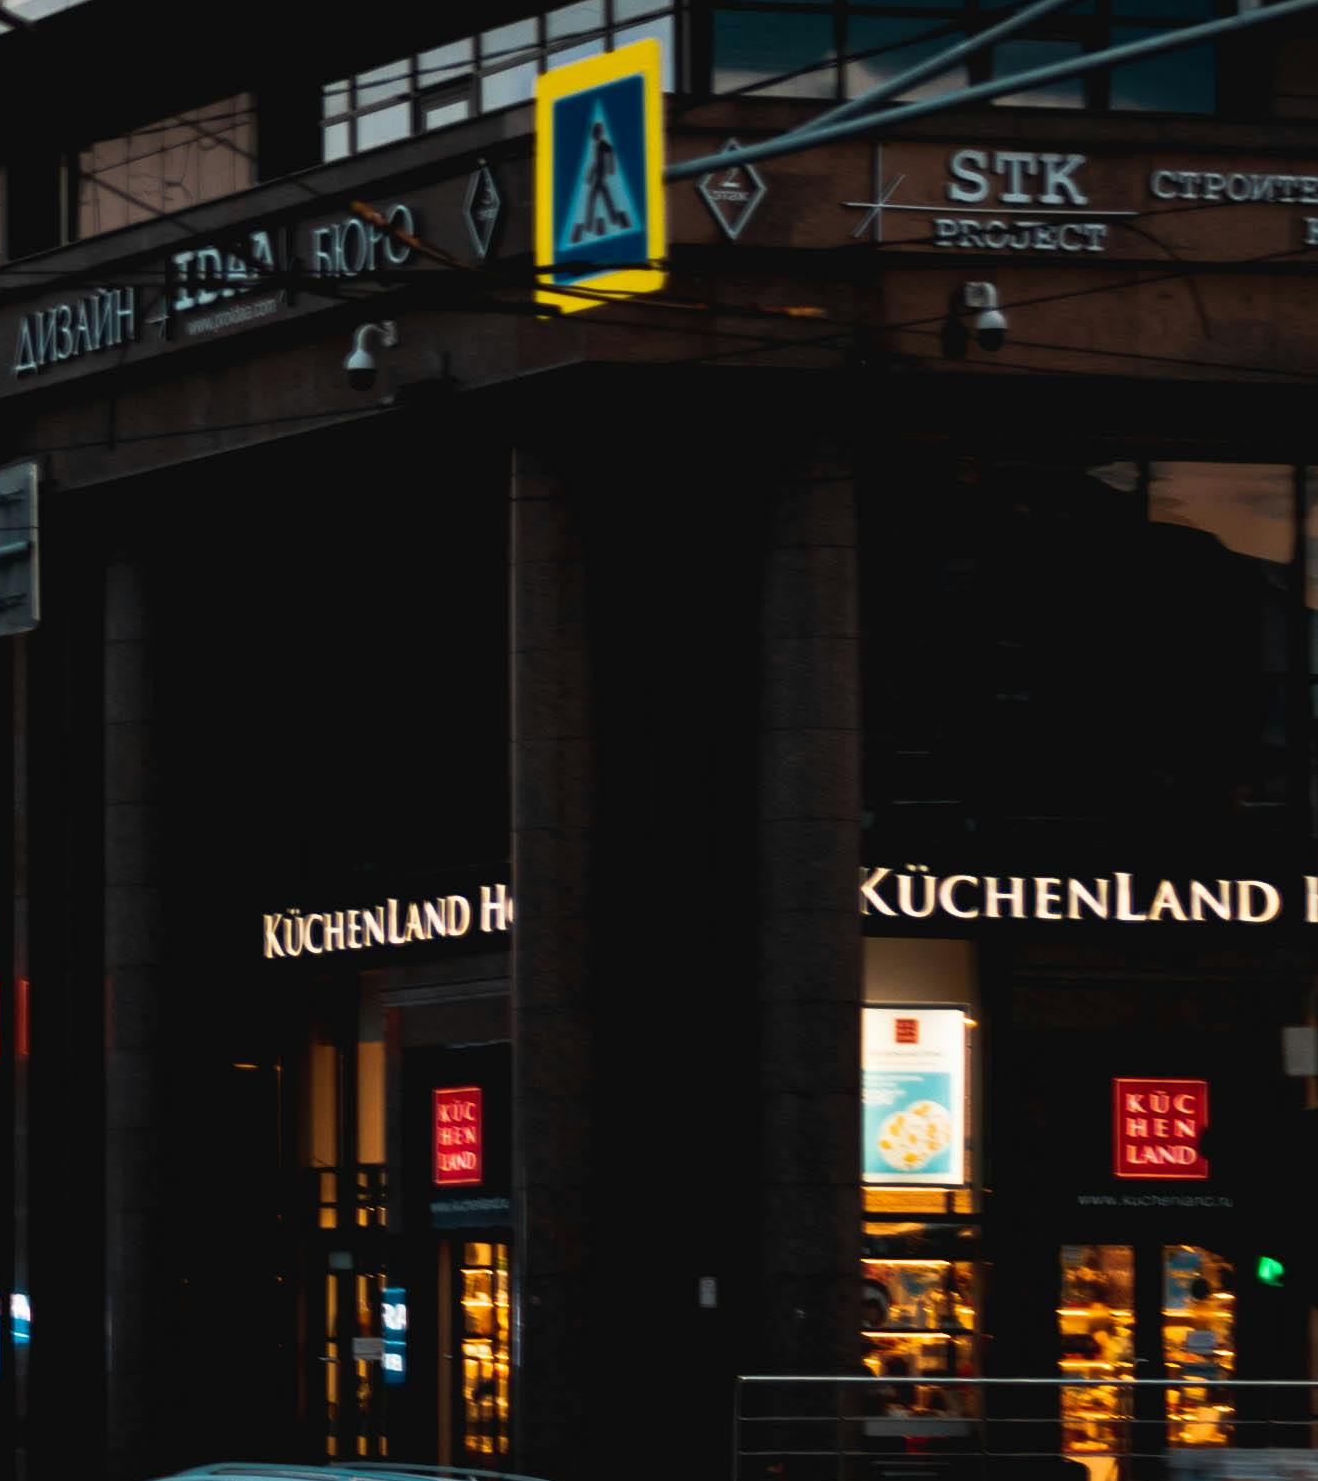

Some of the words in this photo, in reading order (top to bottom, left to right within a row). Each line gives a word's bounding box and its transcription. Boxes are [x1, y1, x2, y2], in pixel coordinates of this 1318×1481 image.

[946, 149, 1090, 206] STK
[310, 202, 416, 279] БЮРО
[933, 217, 1107, 253] PROJECT
[13, 285, 137, 378] ДИЗАЙН
[479, 882, 514, 935] H
[437, 1099, 477, 1123] KÜC
[1125, 1091, 1197, 1116] KÜC
[437, 1125, 477, 1146] HEN
[1126, 1117, 1197, 1140] HEN
[437, 1150, 478, 1172] LAND
[1126, 1144, 1198, 1167] LAND
